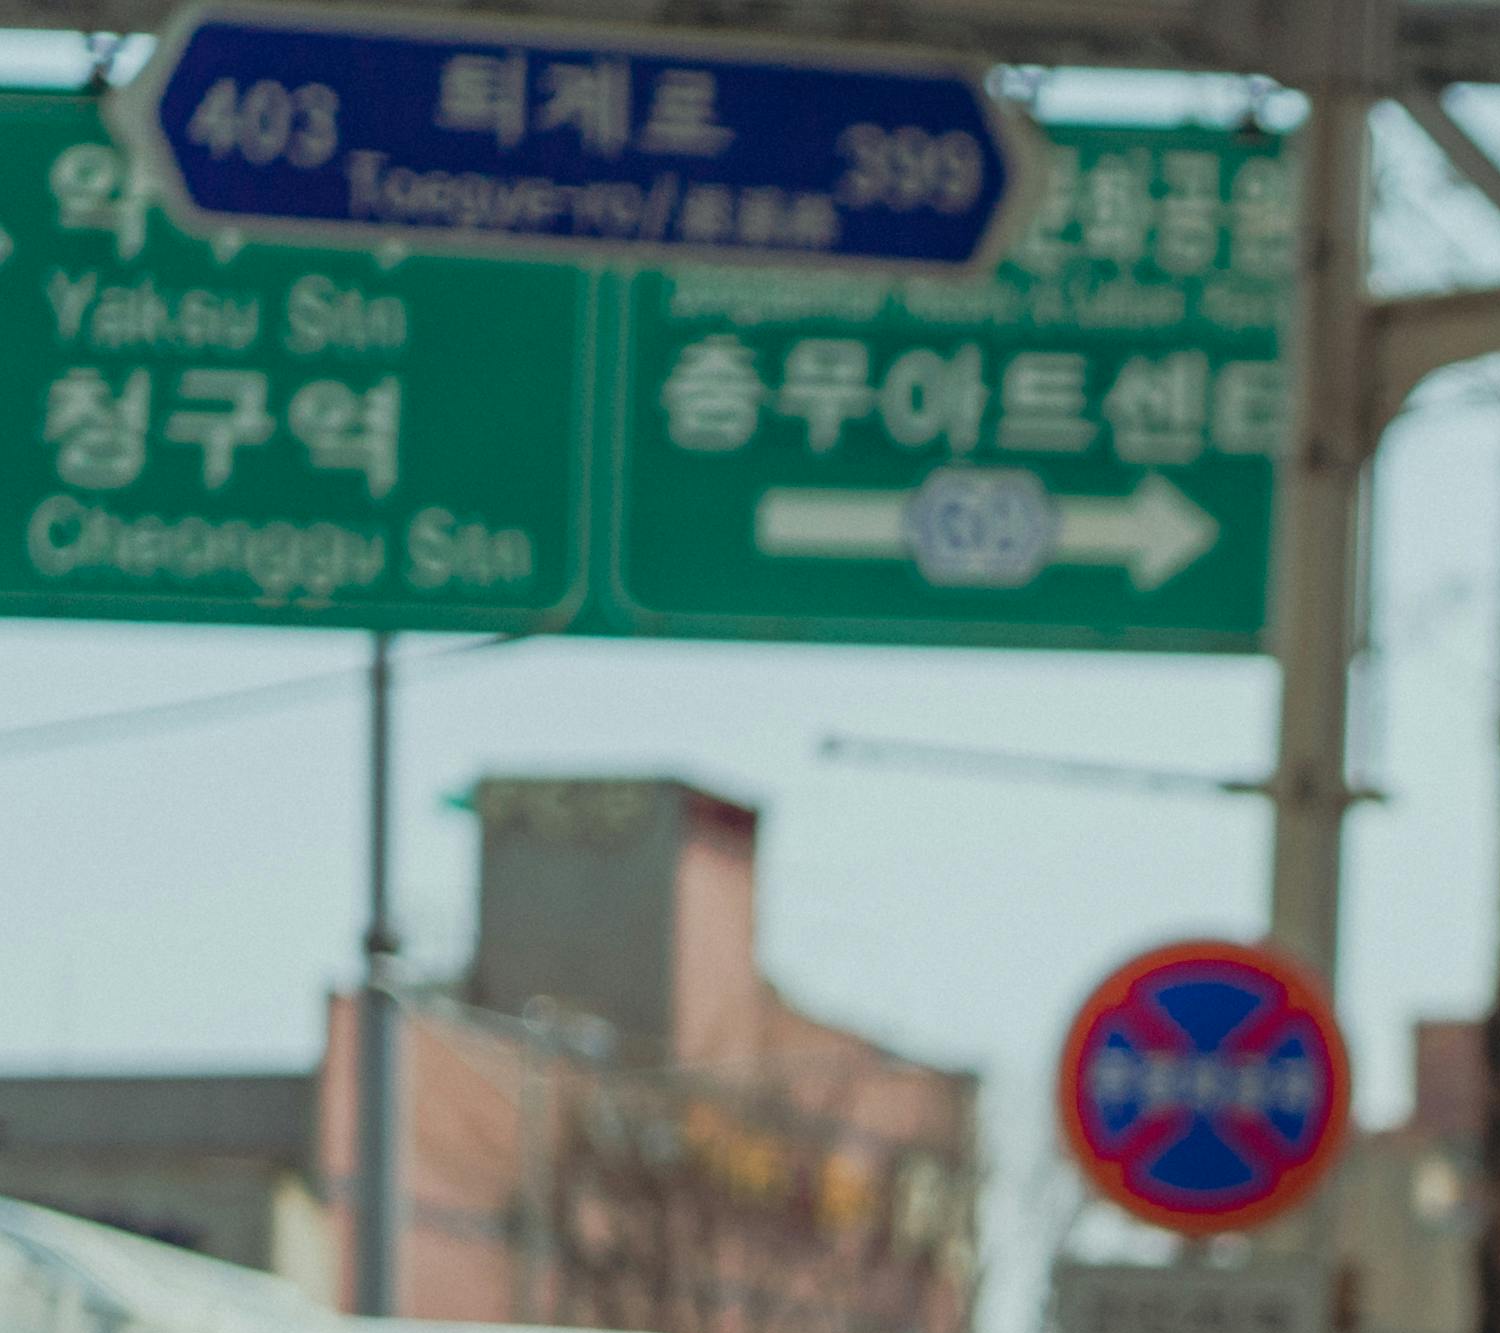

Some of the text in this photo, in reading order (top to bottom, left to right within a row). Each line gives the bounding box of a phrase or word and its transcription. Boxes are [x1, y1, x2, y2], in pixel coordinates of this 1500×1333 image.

[190, 77, 340, 167] 403
[434, 46, 736, 158] 퇴계로
[836, 123, 984, 214] 399
[44, 366, 401, 501] 청구역
